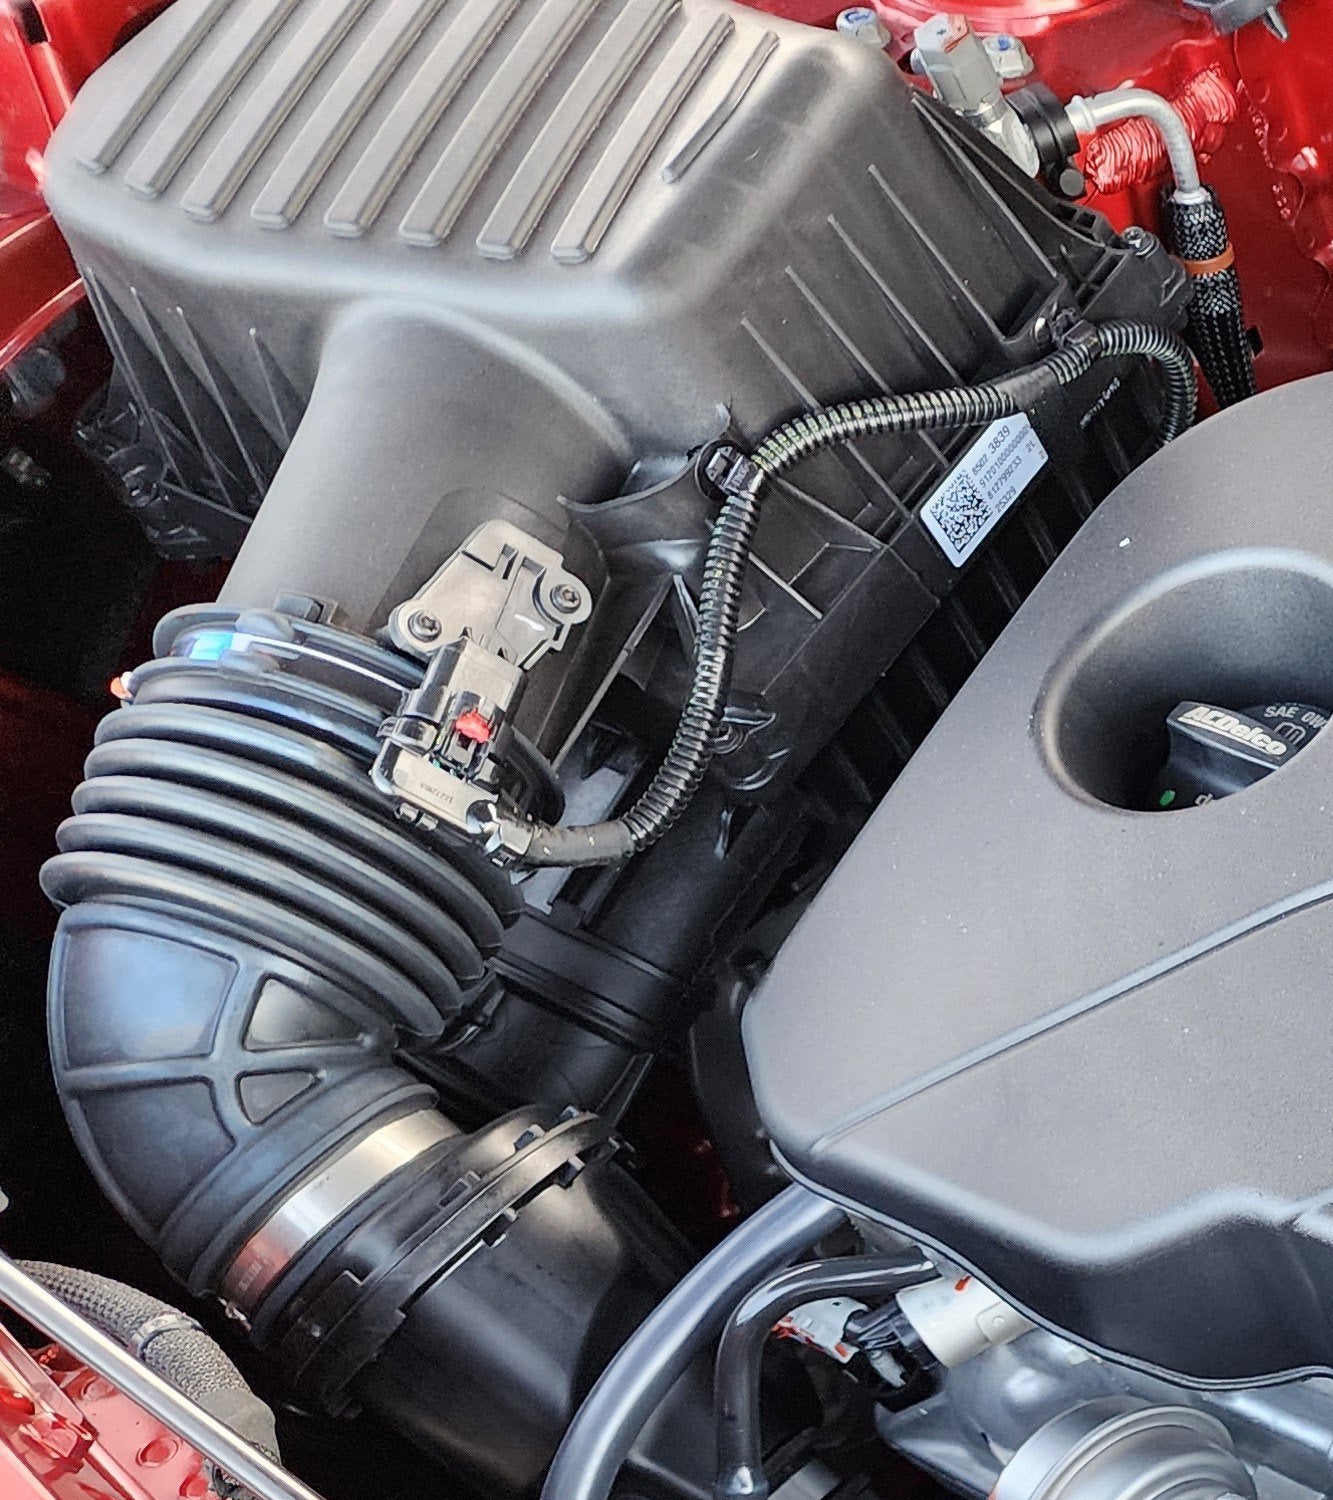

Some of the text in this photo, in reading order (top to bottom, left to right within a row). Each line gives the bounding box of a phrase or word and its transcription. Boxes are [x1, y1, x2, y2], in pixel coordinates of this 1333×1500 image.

[987, 425, 1011, 455] 3839
[1264, 704, 1299, 720] SAE
[1178, 705, 1287, 756] ACDelco
